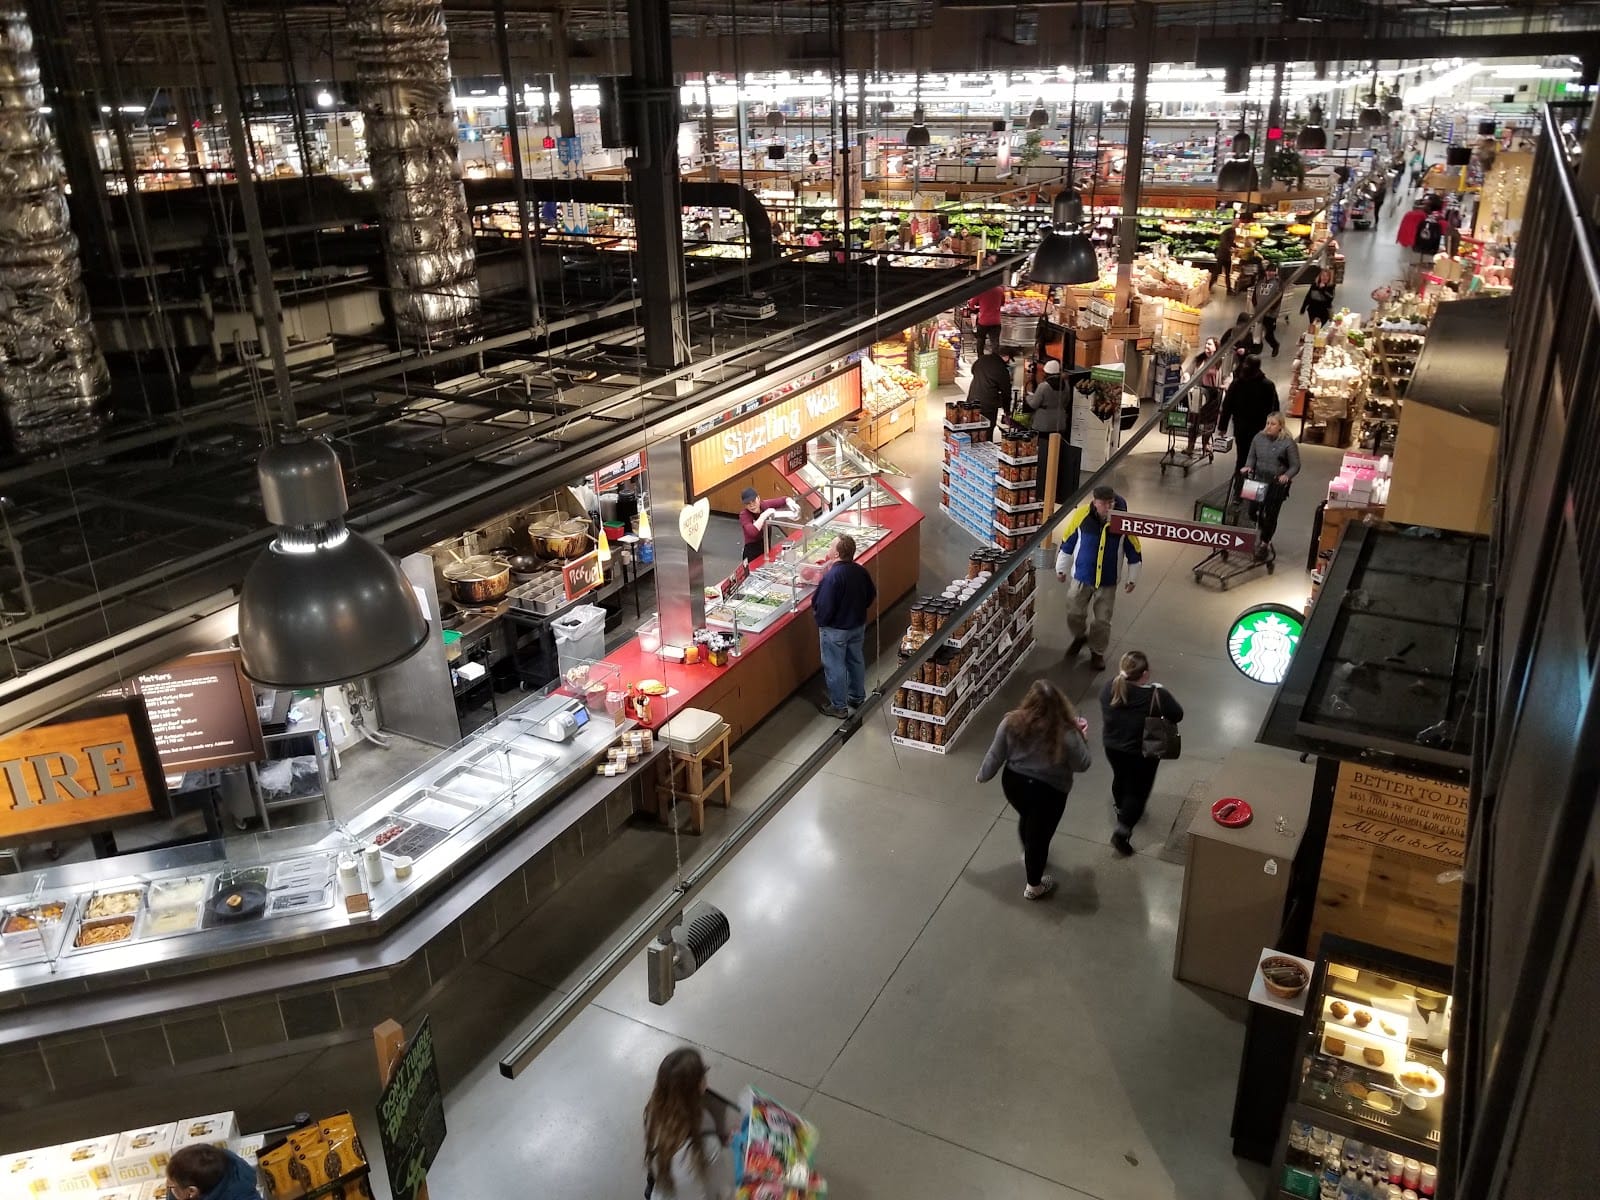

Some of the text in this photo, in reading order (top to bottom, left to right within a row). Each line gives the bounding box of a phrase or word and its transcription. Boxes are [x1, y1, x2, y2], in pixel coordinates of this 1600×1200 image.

[724, 384, 840, 464] Sizzling Wok
[1120, 519, 1230, 546] RESTROOMS
[1354, 772, 1415, 796] BETTER
[1419, 785, 1442, 802] TO
[1367, 807, 1388, 820] GOOD
[1343, 820, 1372, 836] All
[1374, 828, 1396, 843] of
[119, 1165, 150, 1181] GOLD
